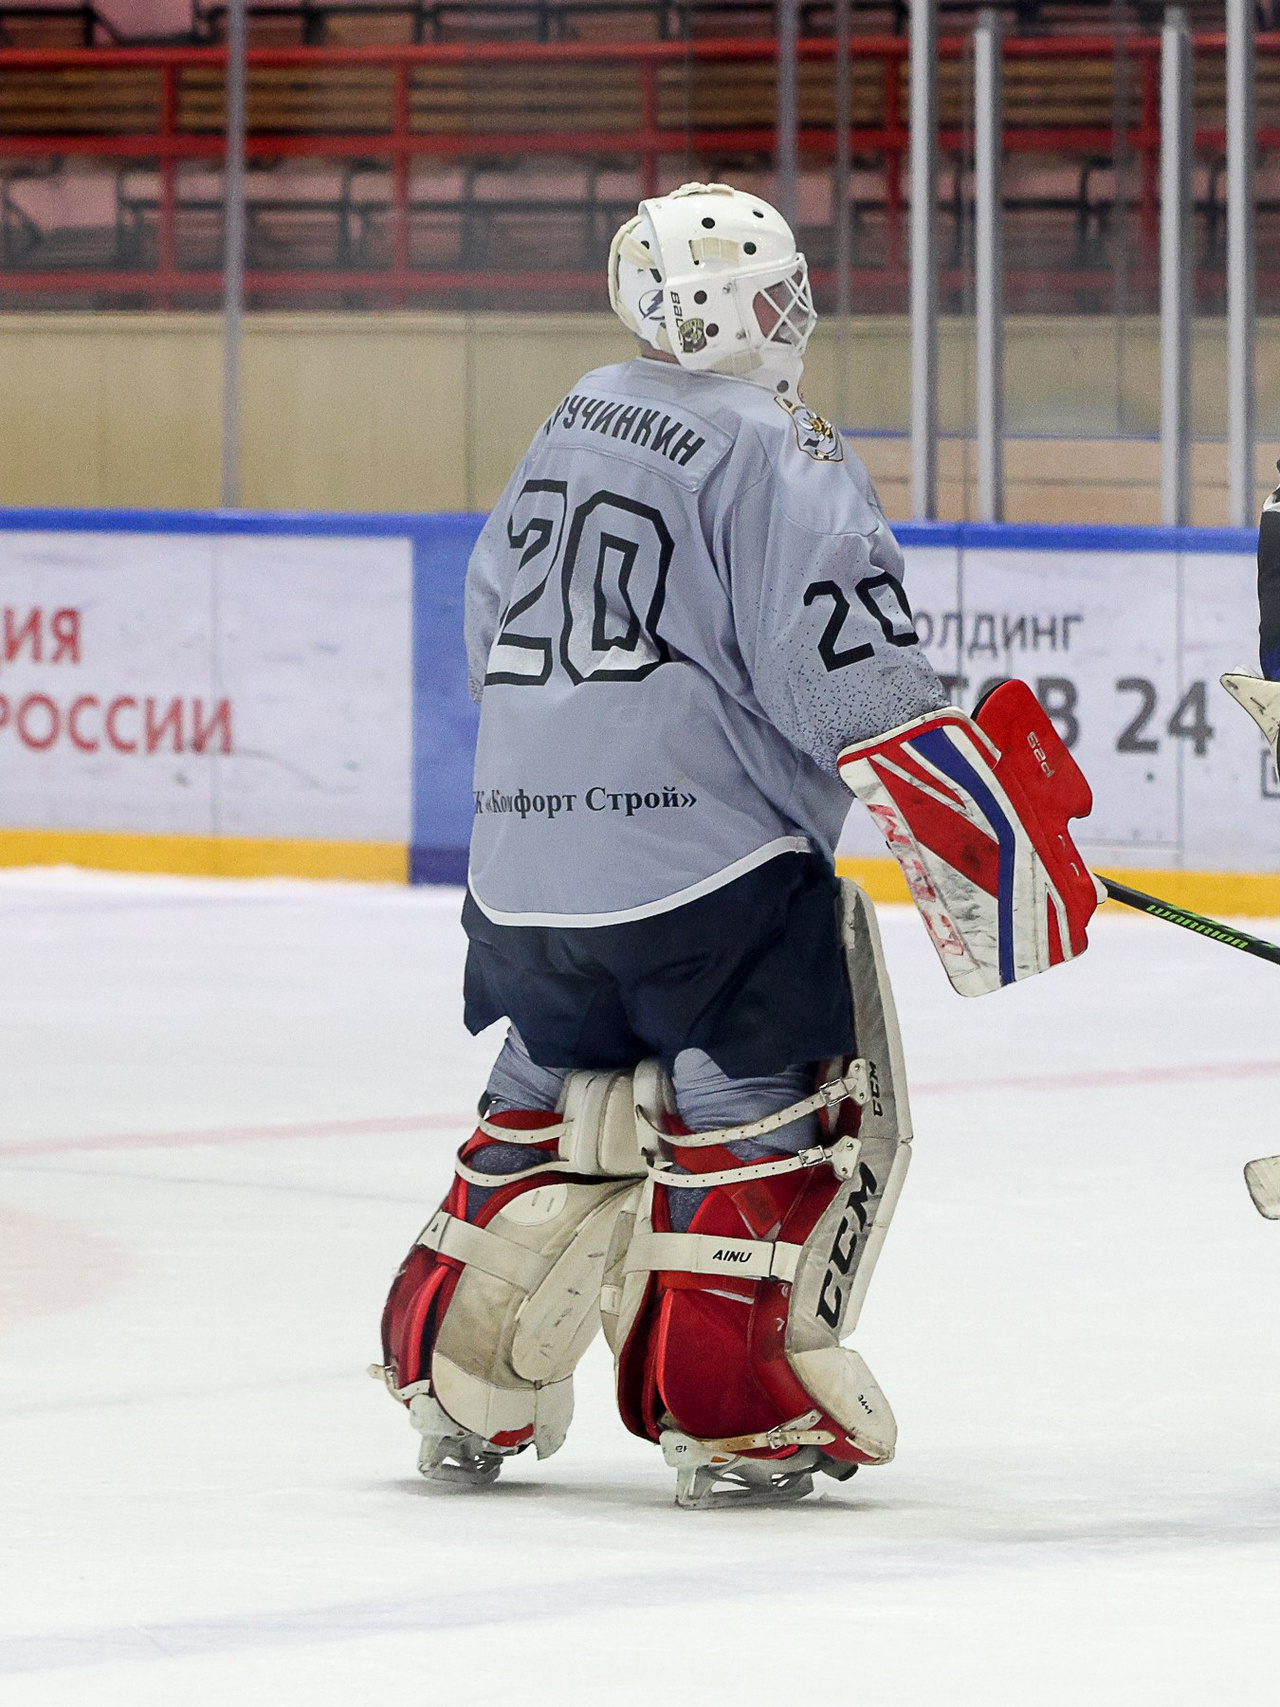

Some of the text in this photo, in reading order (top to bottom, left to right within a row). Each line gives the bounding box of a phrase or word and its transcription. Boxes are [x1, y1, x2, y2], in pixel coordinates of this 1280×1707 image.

[544, 395, 706, 466] РУЧИНКИН
[484, 480, 675, 687] 20
[803, 570, 918, 672] 20
[913, 610, 1084, 658] олдинг
[1116, 680, 1214, 757] 24
[585, 786, 698, 817] Строй»
[1146, 904, 1249, 950] WARRIOR
[868, 1060, 884, 1117] CCM
[712, 1249, 753, 1263] AINU
[815, 1161, 878, 1328] CCM
